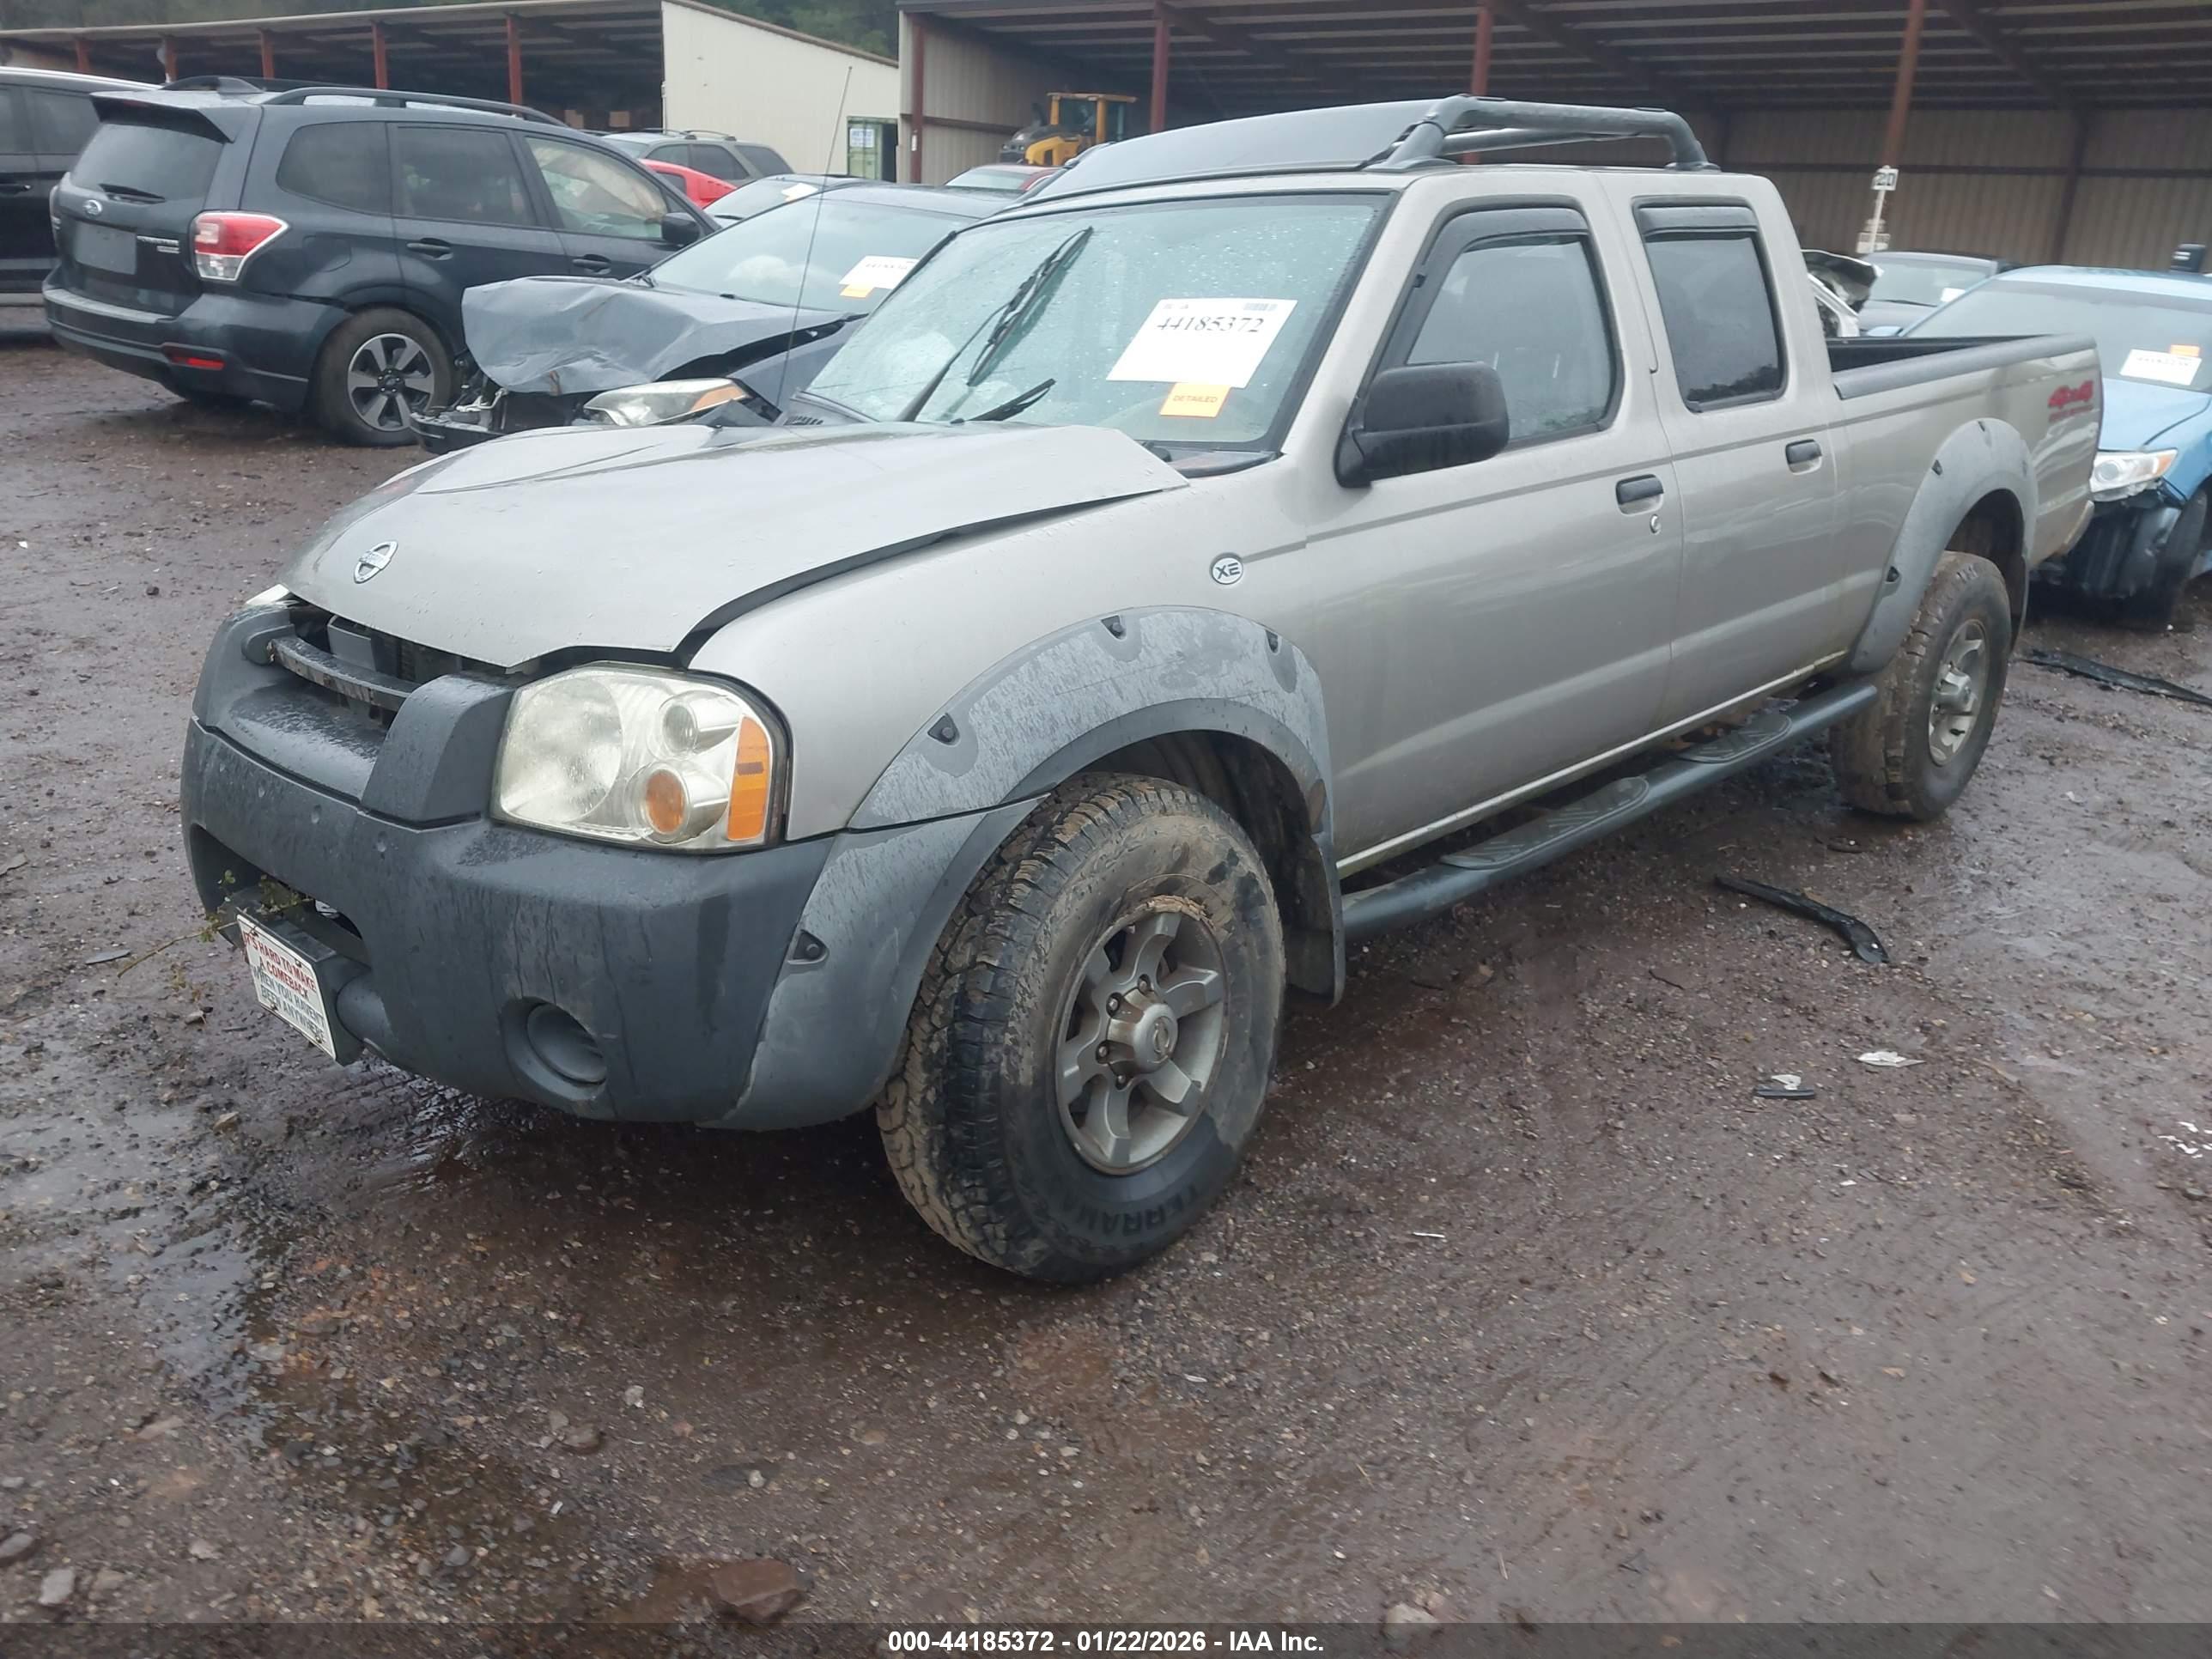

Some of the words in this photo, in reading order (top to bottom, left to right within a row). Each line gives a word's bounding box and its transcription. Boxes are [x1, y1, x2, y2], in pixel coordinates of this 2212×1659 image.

[1157, 316, 1264, 332] 44185372
[1215, 562, 1240, 579] XE
[252, 964, 274, 990] WHEN
[275, 981, 293, 1003] YOU
[258, 940, 281, 966] HARD
[281, 957, 293, 975] TO
[293, 965, 317, 993] MAKE
[258, 955, 265, 969] A
[265, 960, 309, 1000] COMEBACK
[261, 983, 282, 1008] BEEN
[283, 1000, 325, 1042] ANYWHERE
